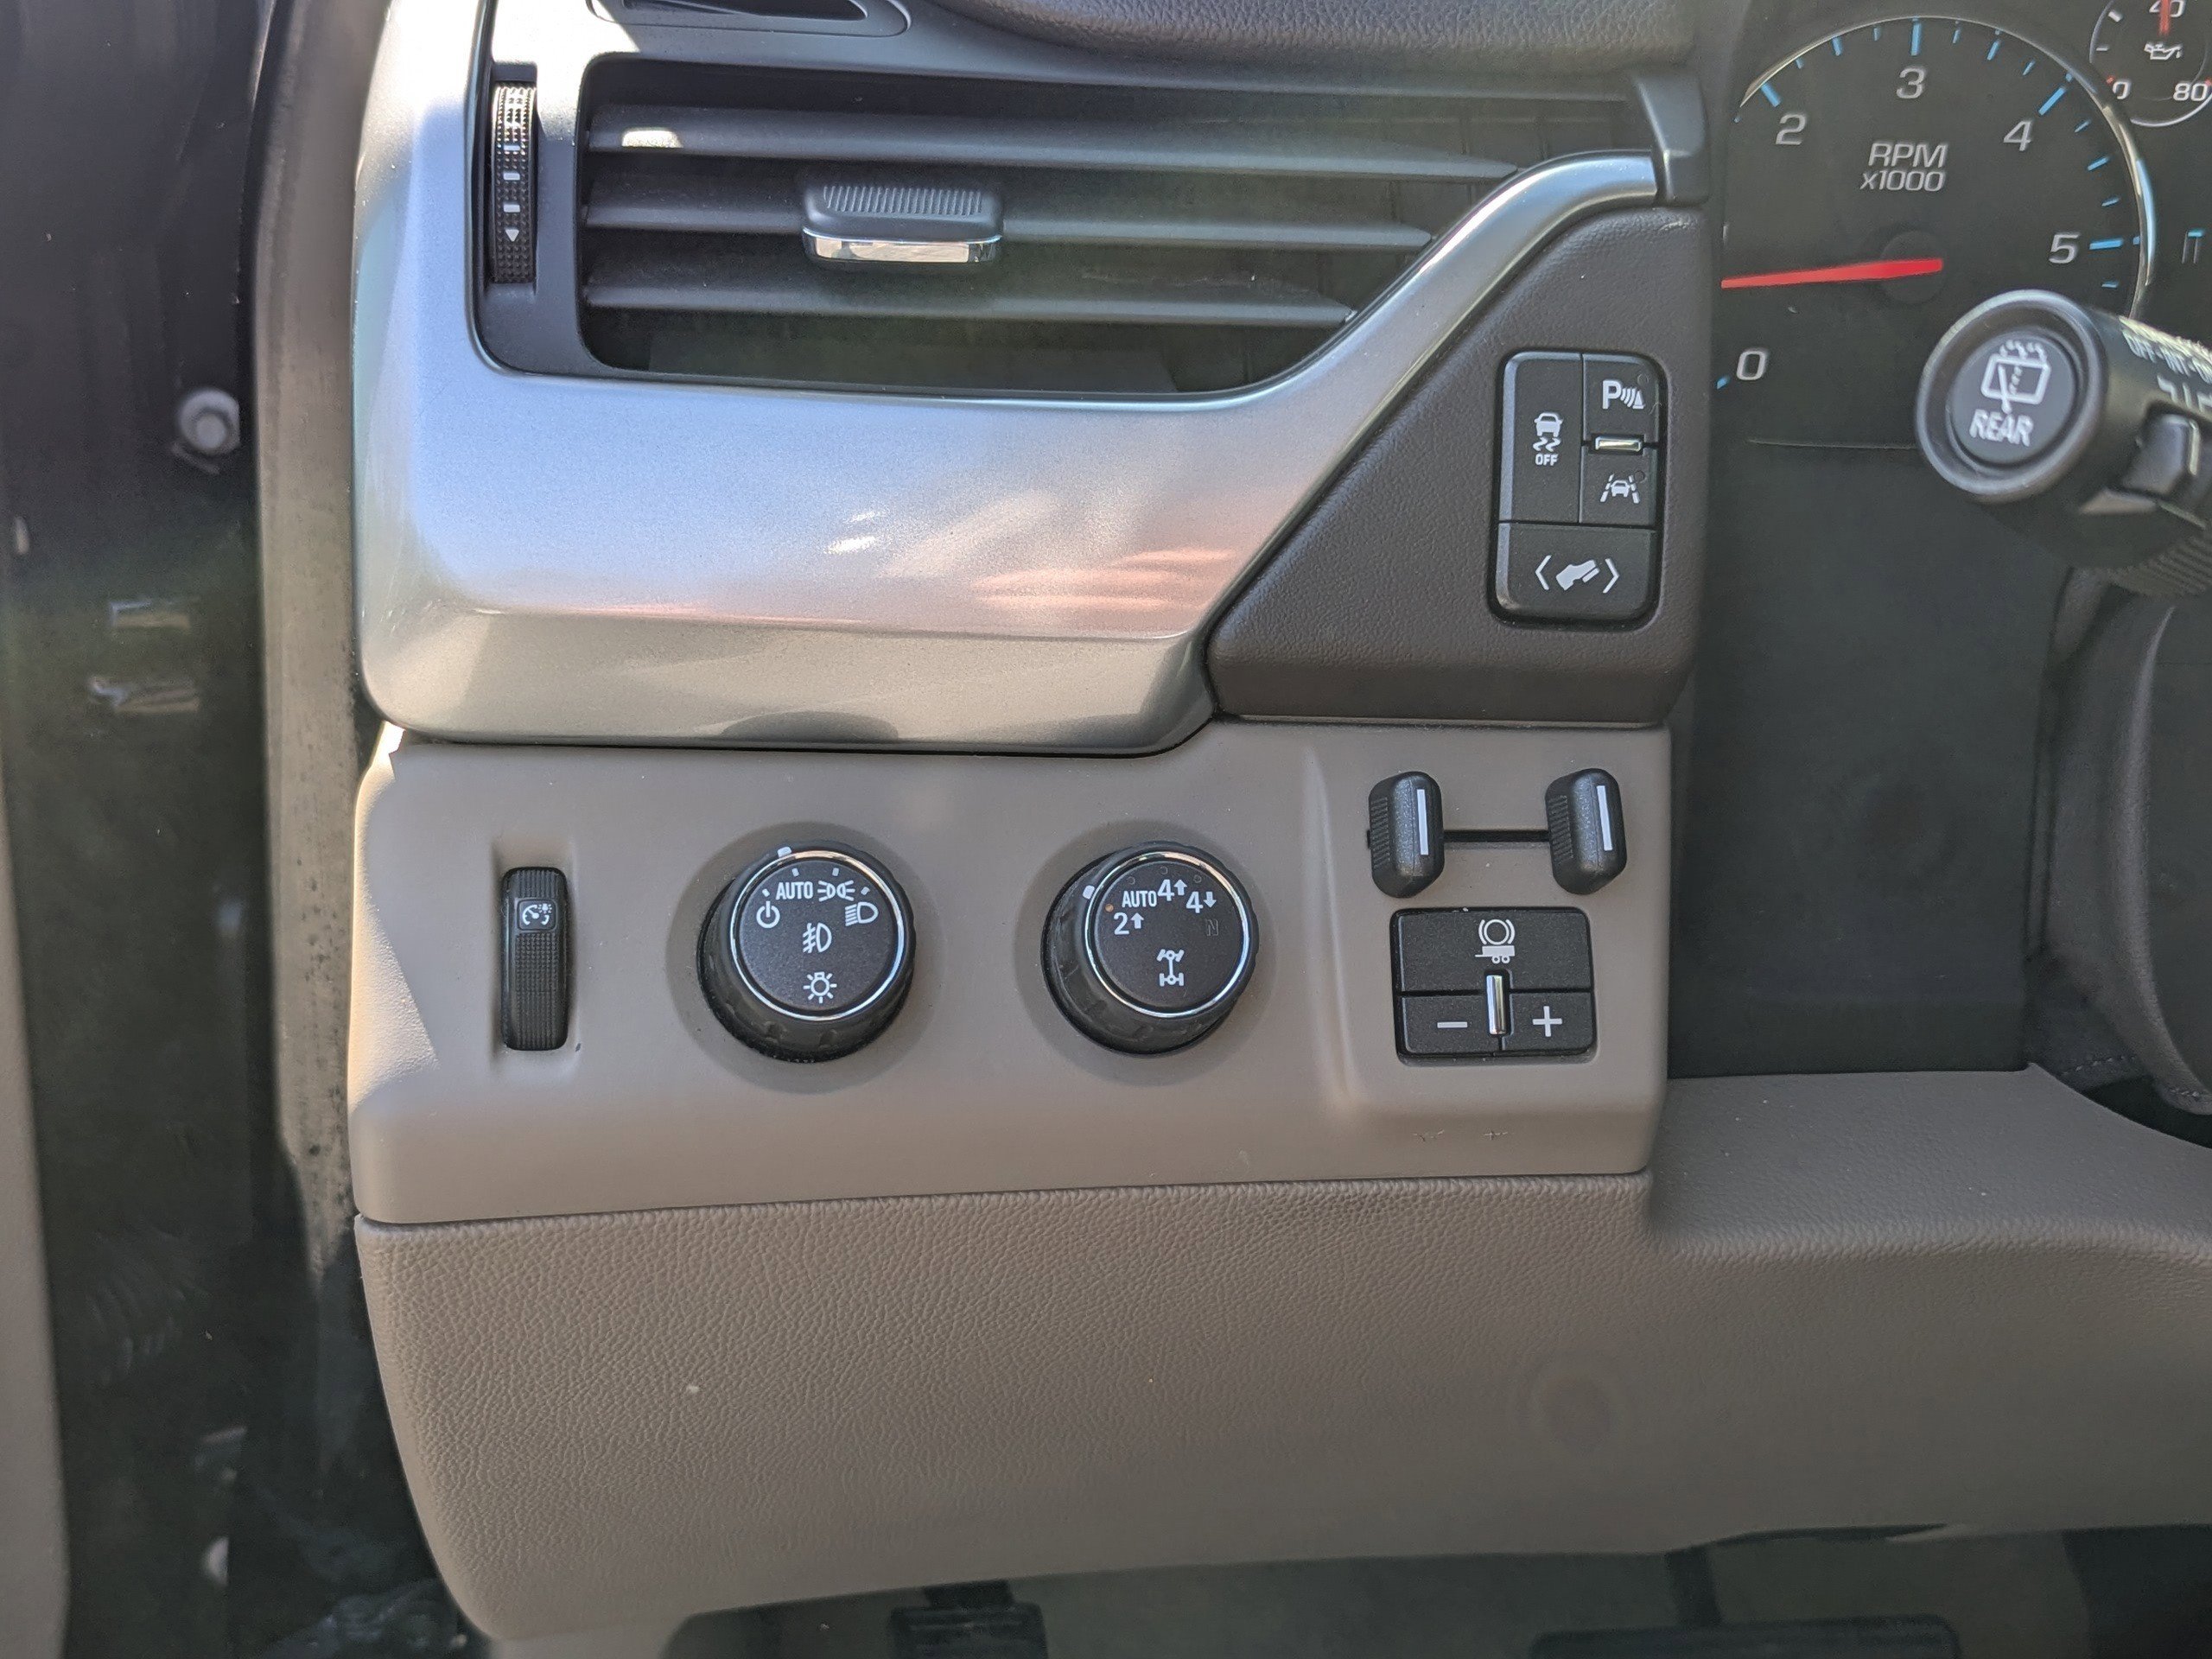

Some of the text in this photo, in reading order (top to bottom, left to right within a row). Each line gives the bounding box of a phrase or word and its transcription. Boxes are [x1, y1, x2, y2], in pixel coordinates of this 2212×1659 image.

[1897, 67, 1926, 99] 3
[2172, 82, 2209, 102] 80
[1776, 113, 1807, 145] 2
[2003, 120, 2033, 151] 4
[1868, 142, 1948, 168] RPM
[1859, 169, 1947, 192] x1000
[2049, 232, 2081, 264] 5
[1736, 348, 1768, 381] 0
[1969, 408, 2034, 447] REAR
[1535, 453, 1560, 467] OFF
[776, 880, 814, 900] AUTO
[1122, 890, 1158, 908] AUTO
[1157, 879, 1175, 902] 4
[1185, 891, 1204, 913] 4
[1113, 912, 1130, 935] 2
